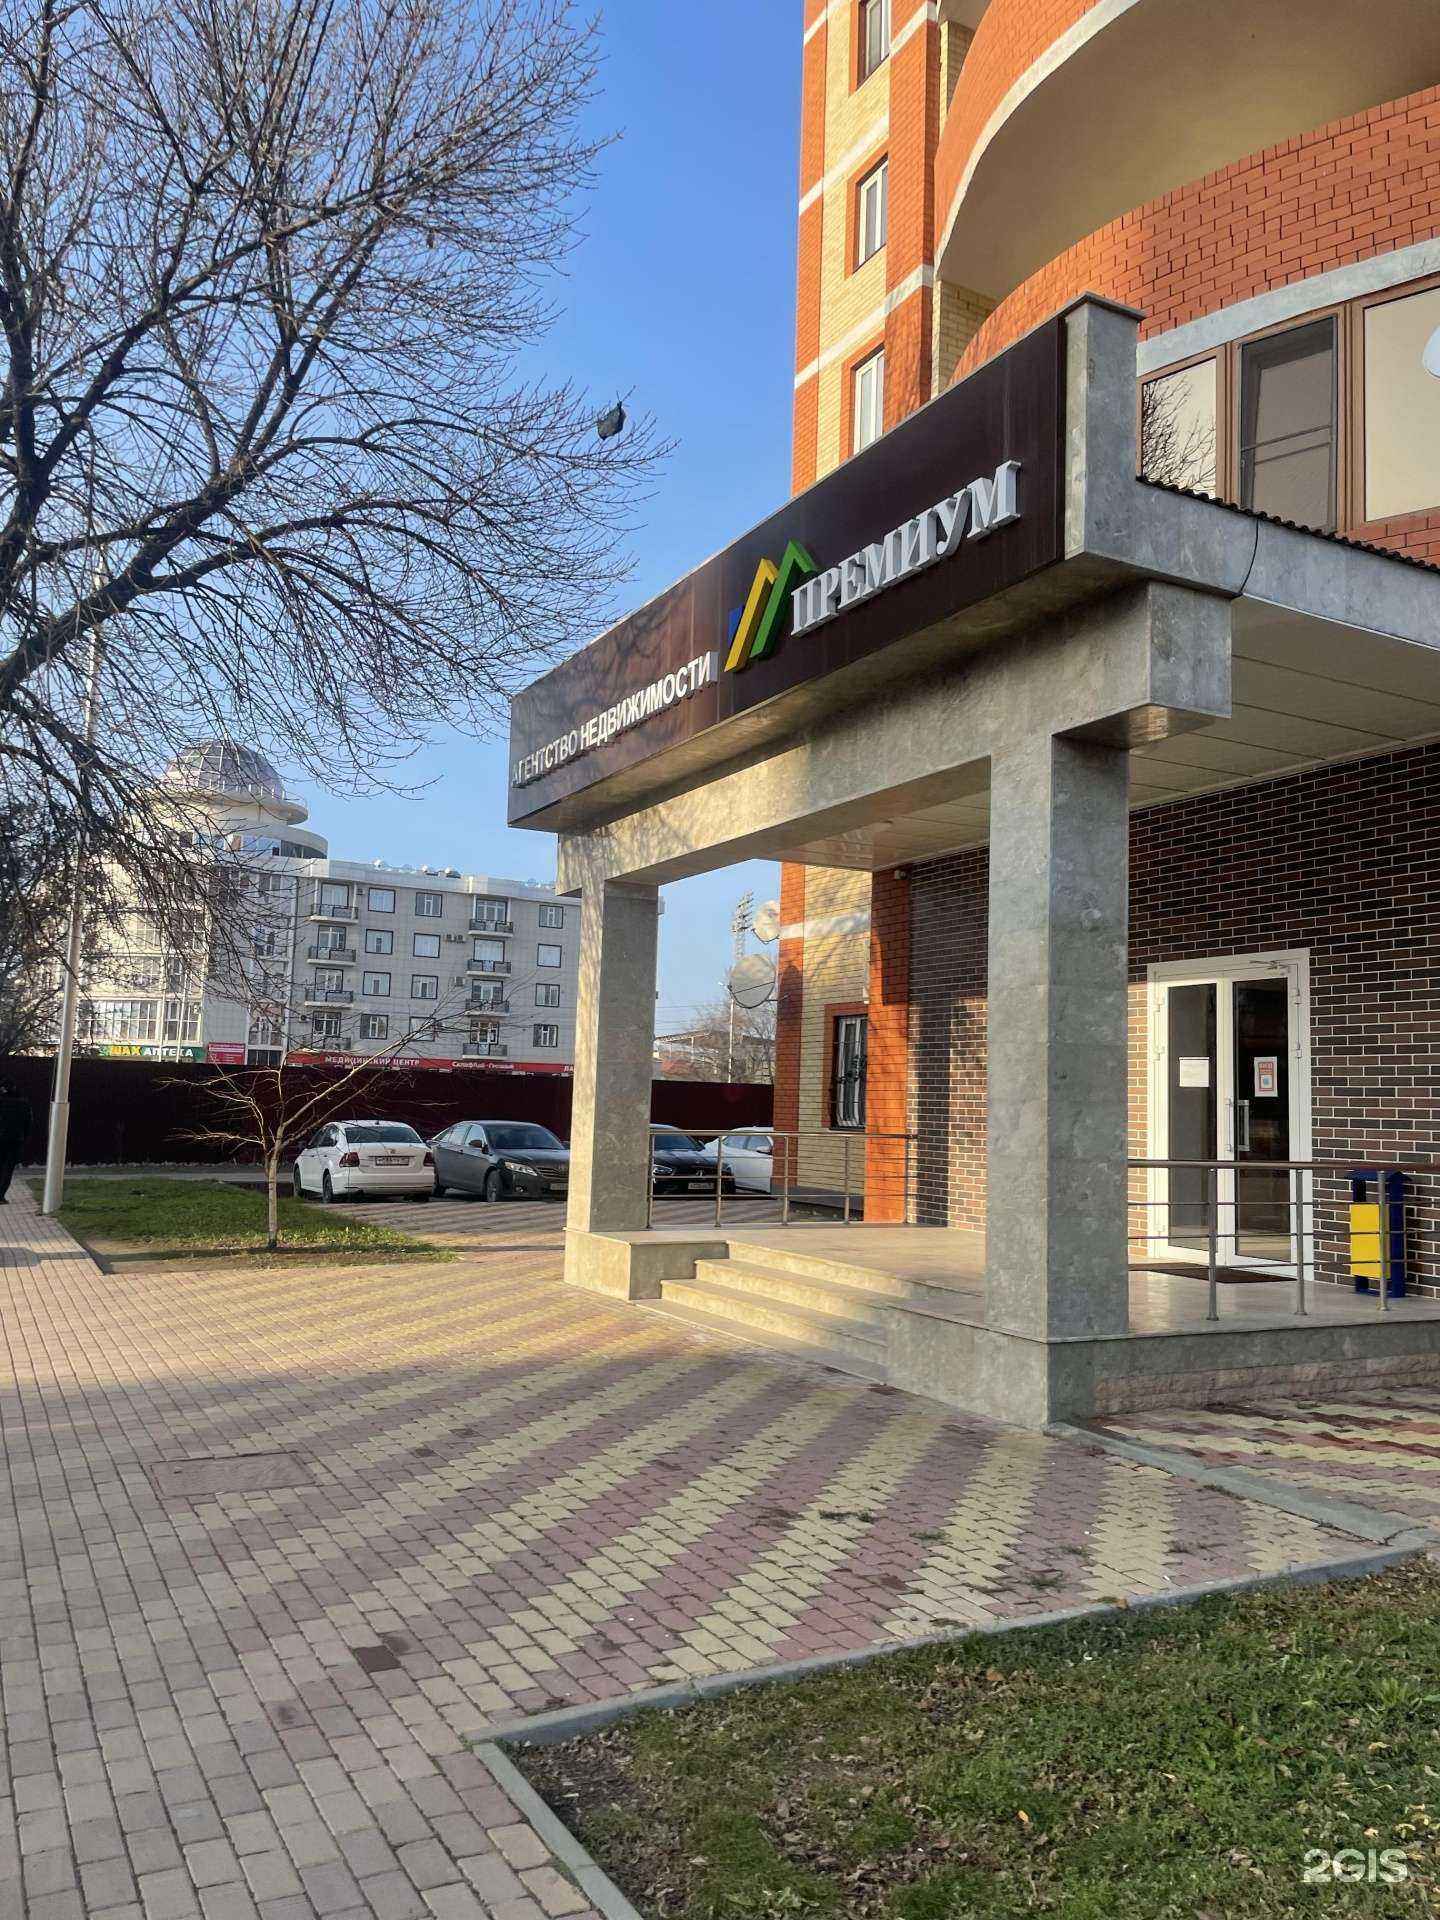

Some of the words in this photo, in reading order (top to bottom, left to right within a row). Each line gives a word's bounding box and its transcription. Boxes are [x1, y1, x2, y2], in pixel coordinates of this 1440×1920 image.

[791, 460, 1021, 637] ПРЕМИУМ
[512, 730, 578, 786] АГЕНТСТВО
[580, 651, 718, 747] НЕДВИЖИМОСТИ
